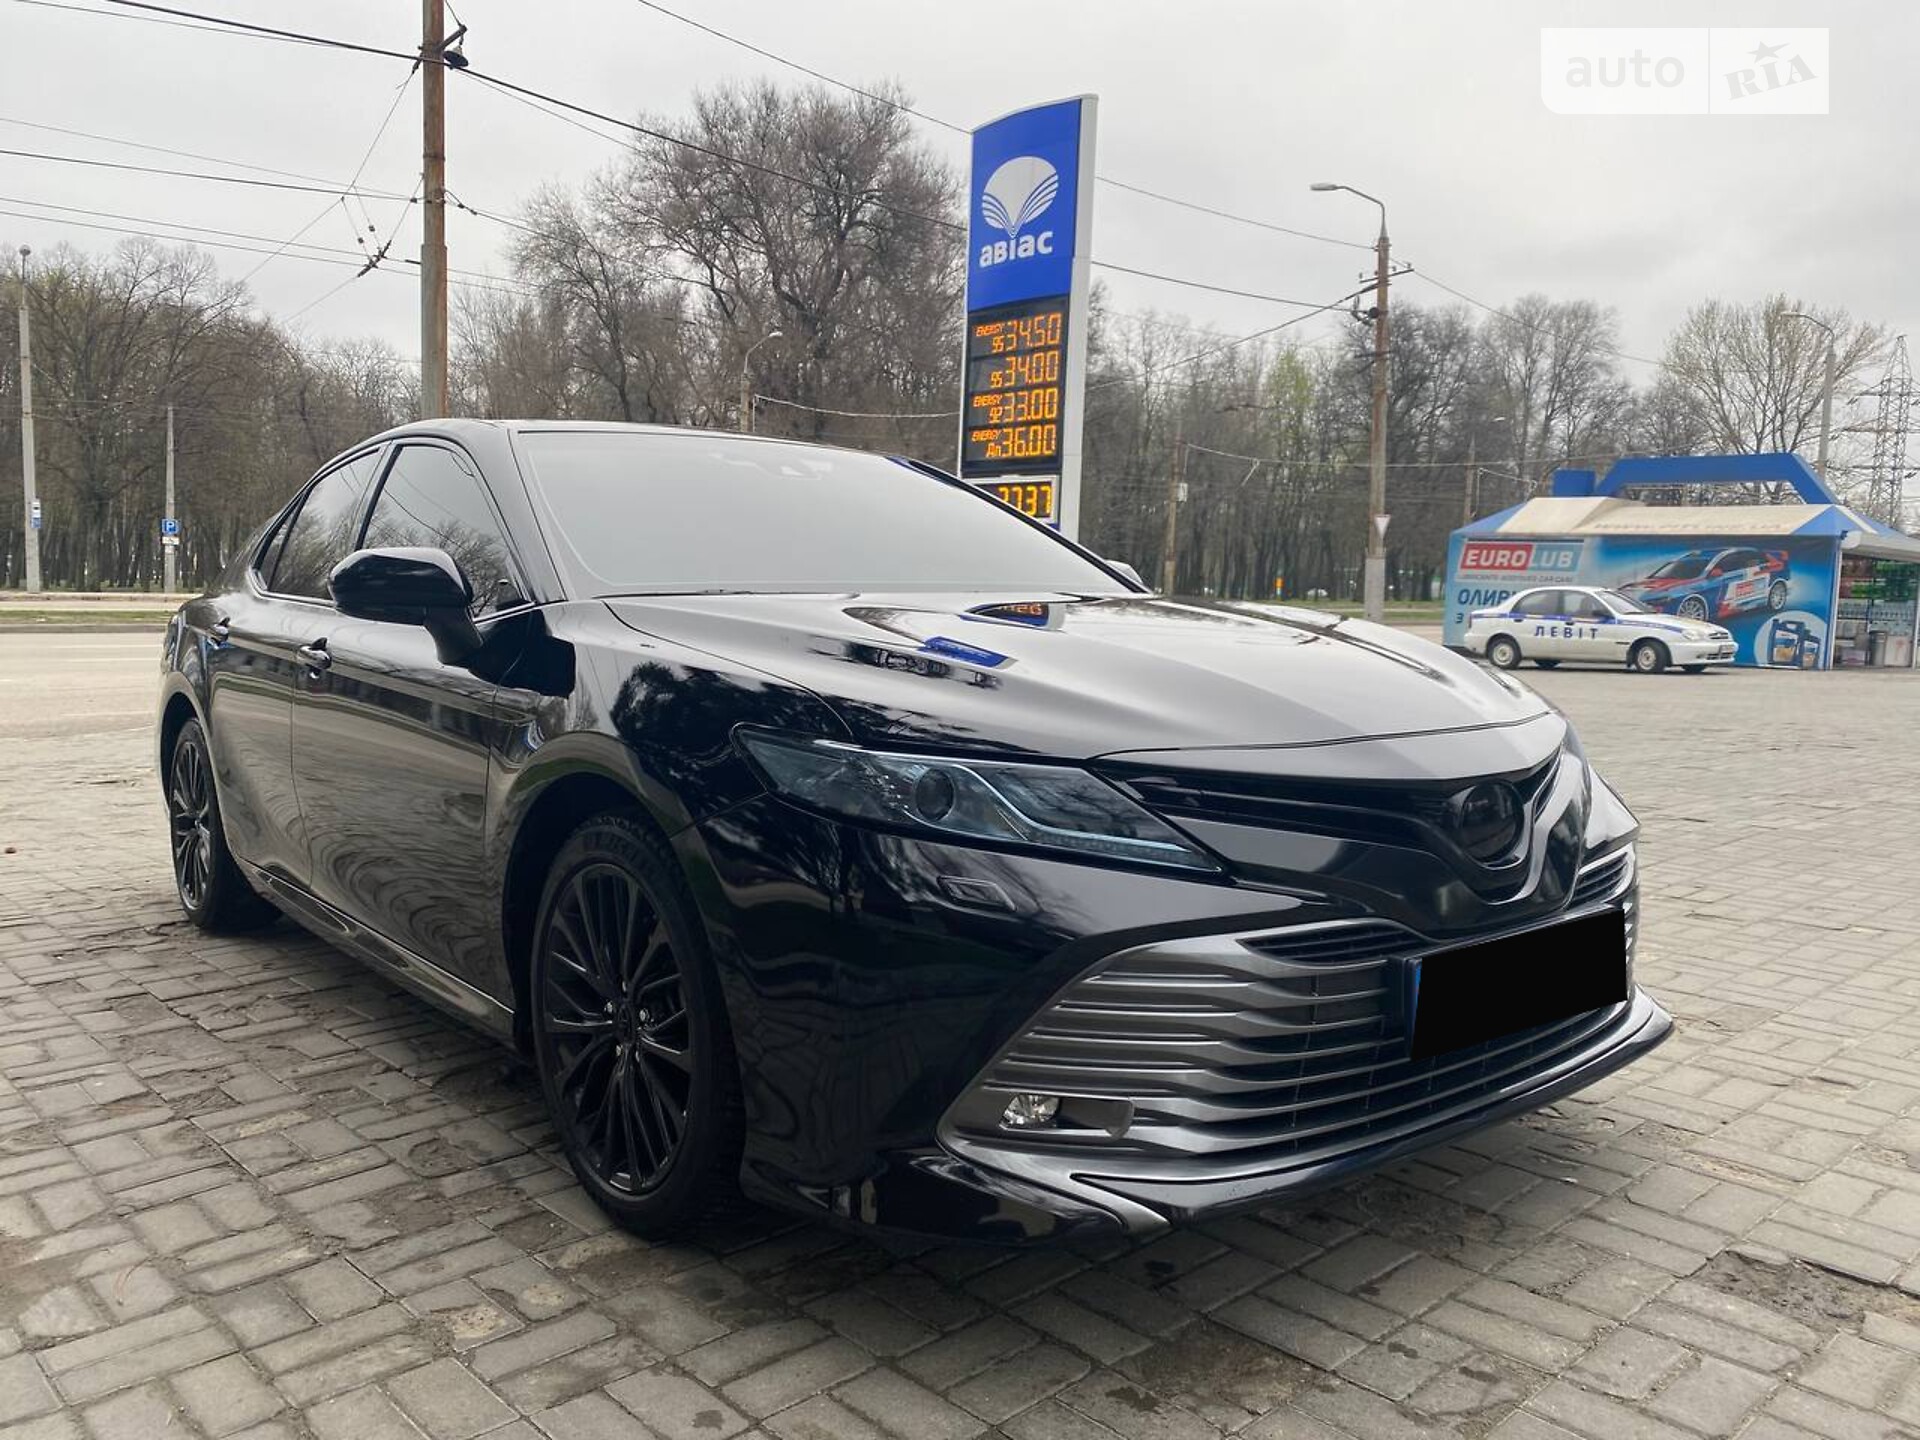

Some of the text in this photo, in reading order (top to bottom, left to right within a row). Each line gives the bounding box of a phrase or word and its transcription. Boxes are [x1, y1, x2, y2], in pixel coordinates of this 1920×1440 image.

[1005, 313, 1061, 352] 34.50
[1004, 350, 1059, 386] 34.00
[1003, 388, 1058, 422] 33.00
[1001, 424, 1056, 457] 36.00
[1465, 549, 1574, 568] EUROLUB
[1534, 626, 1599, 639] ЛЕВІТ
